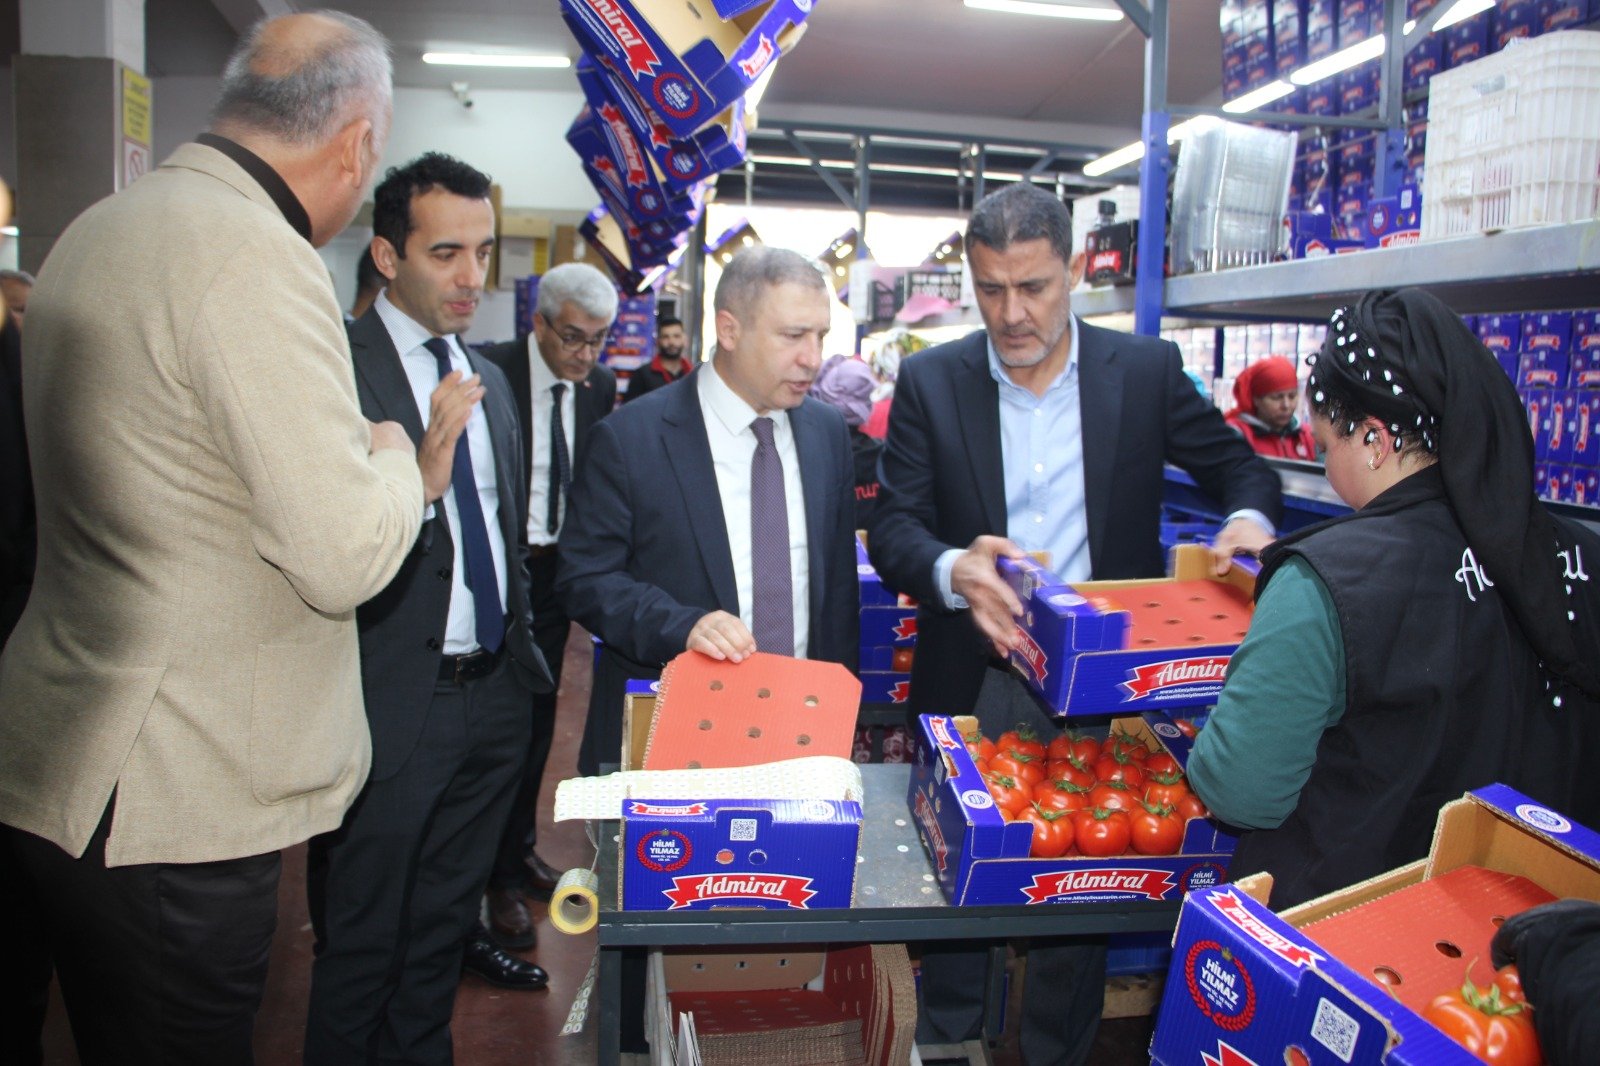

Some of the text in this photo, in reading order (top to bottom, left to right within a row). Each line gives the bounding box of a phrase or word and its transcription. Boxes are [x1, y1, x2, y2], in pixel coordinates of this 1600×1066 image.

[650, 847, 680, 855] YILMAZ
[652, 839, 676, 848] HİLMİ
[695, 876, 787, 898] Admiral
[1055, 871, 1149, 894] Admiral
[1206, 957, 1236, 989] HİLMİ
[1201, 966, 1239, 1006] YILMAZ
